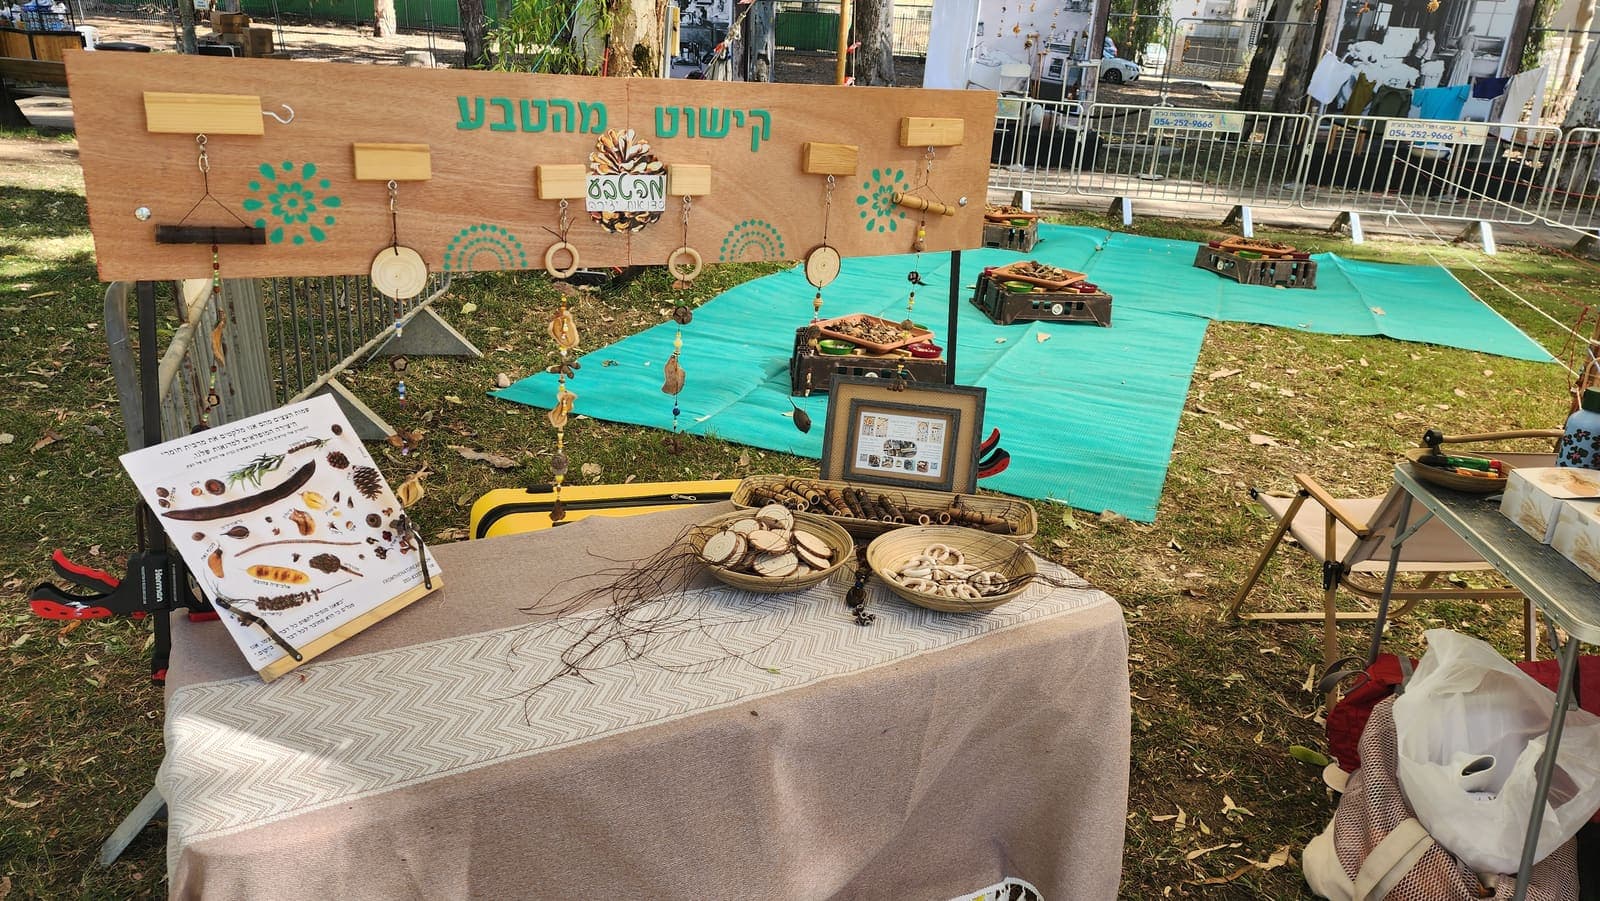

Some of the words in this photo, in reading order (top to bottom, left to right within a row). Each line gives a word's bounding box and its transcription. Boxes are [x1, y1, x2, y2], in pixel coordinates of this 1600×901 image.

[457, 96, 608, 134] מהטבע
[1153, 118, 1213, 128] 054-252-9666
[655, 106, 772, 152] קישוט
[1389, 129, 1454, 140] 054-252-9666
[259, 417, 274, 427] מהם
[274, 412, 293, 423] העצים
[247, 423, 257, 432] אנו
[275, 421, 298, 433] היצירה
[208, 434, 219, 444] את
[220, 426, 247, 441] מלקטים
[242, 427, 275, 444] המופלאים
[184, 438, 207, 451] מרבית
[160, 446, 183, 457] חומרי
